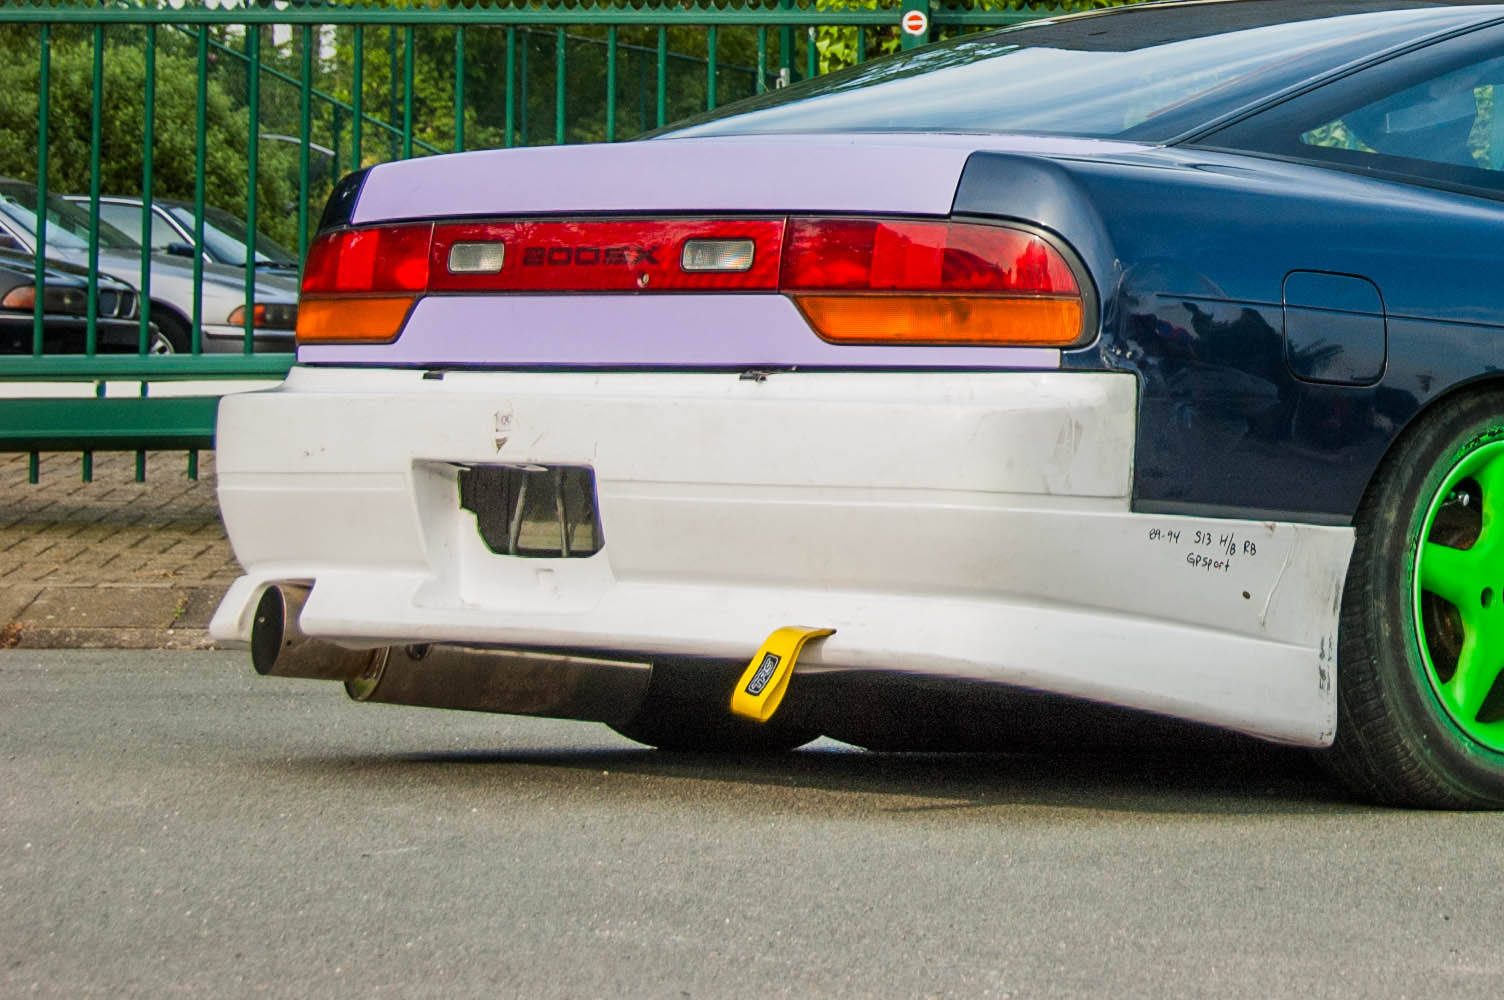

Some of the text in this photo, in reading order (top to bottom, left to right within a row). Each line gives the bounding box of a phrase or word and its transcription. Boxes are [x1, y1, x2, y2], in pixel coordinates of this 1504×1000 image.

[522, 246, 659, 265] 200SX
[1193, 530, 1212, 546] S13
[1243, 540, 1257, 556] RB
